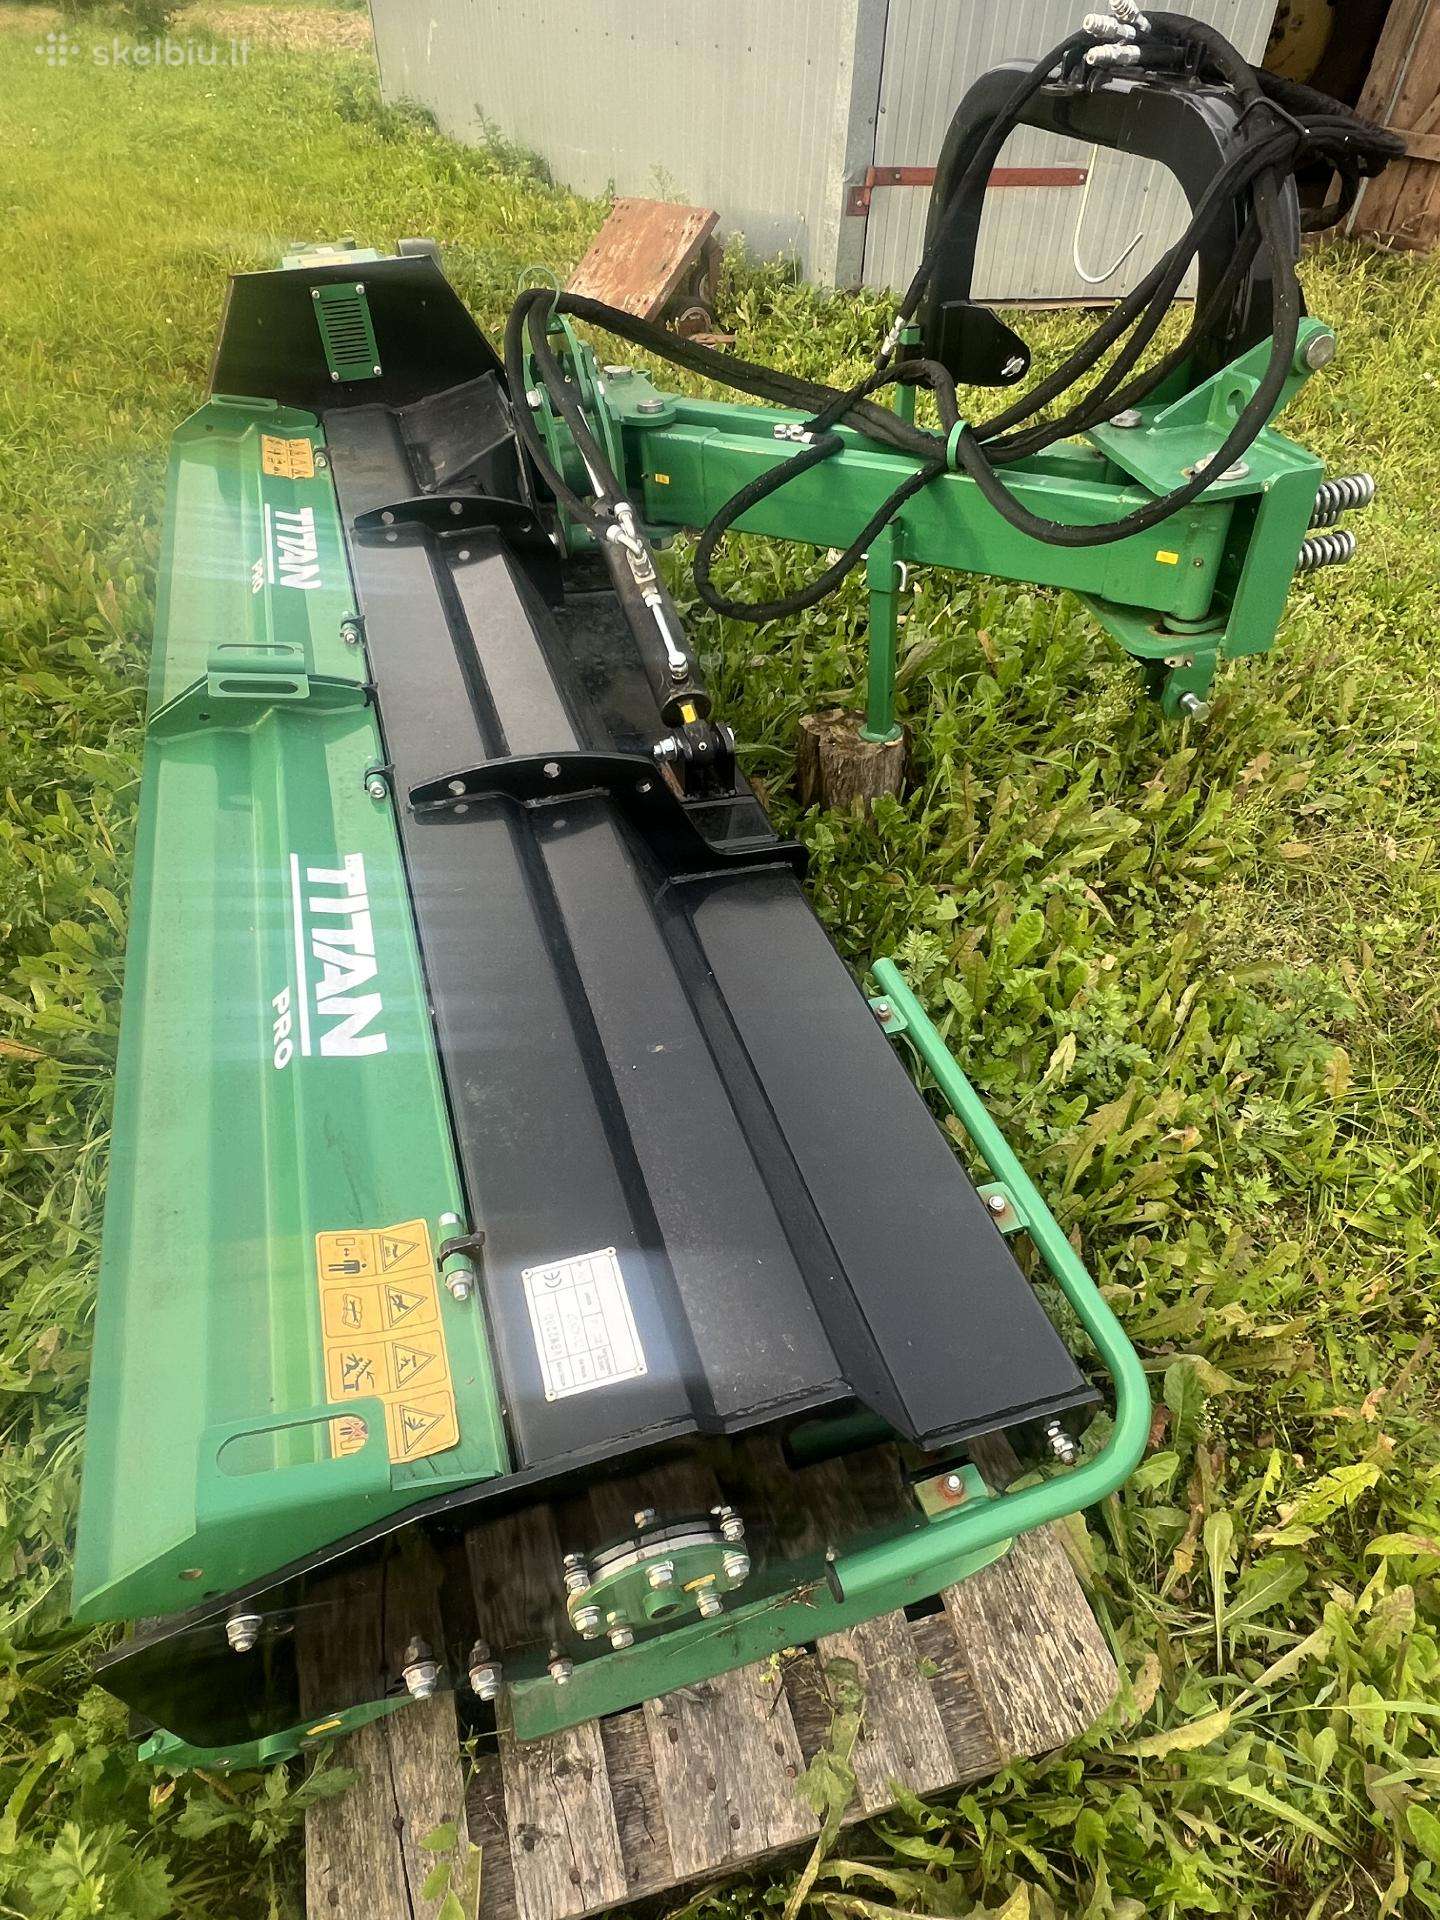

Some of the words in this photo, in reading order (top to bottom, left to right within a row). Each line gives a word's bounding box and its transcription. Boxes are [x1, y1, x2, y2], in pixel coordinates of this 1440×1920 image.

[251, 557, 264, 594] PRO
[275, 507, 322, 590] TITAN
[306, 853, 388, 1057] TITAN
[272, 985, 293, 1070] PRO
